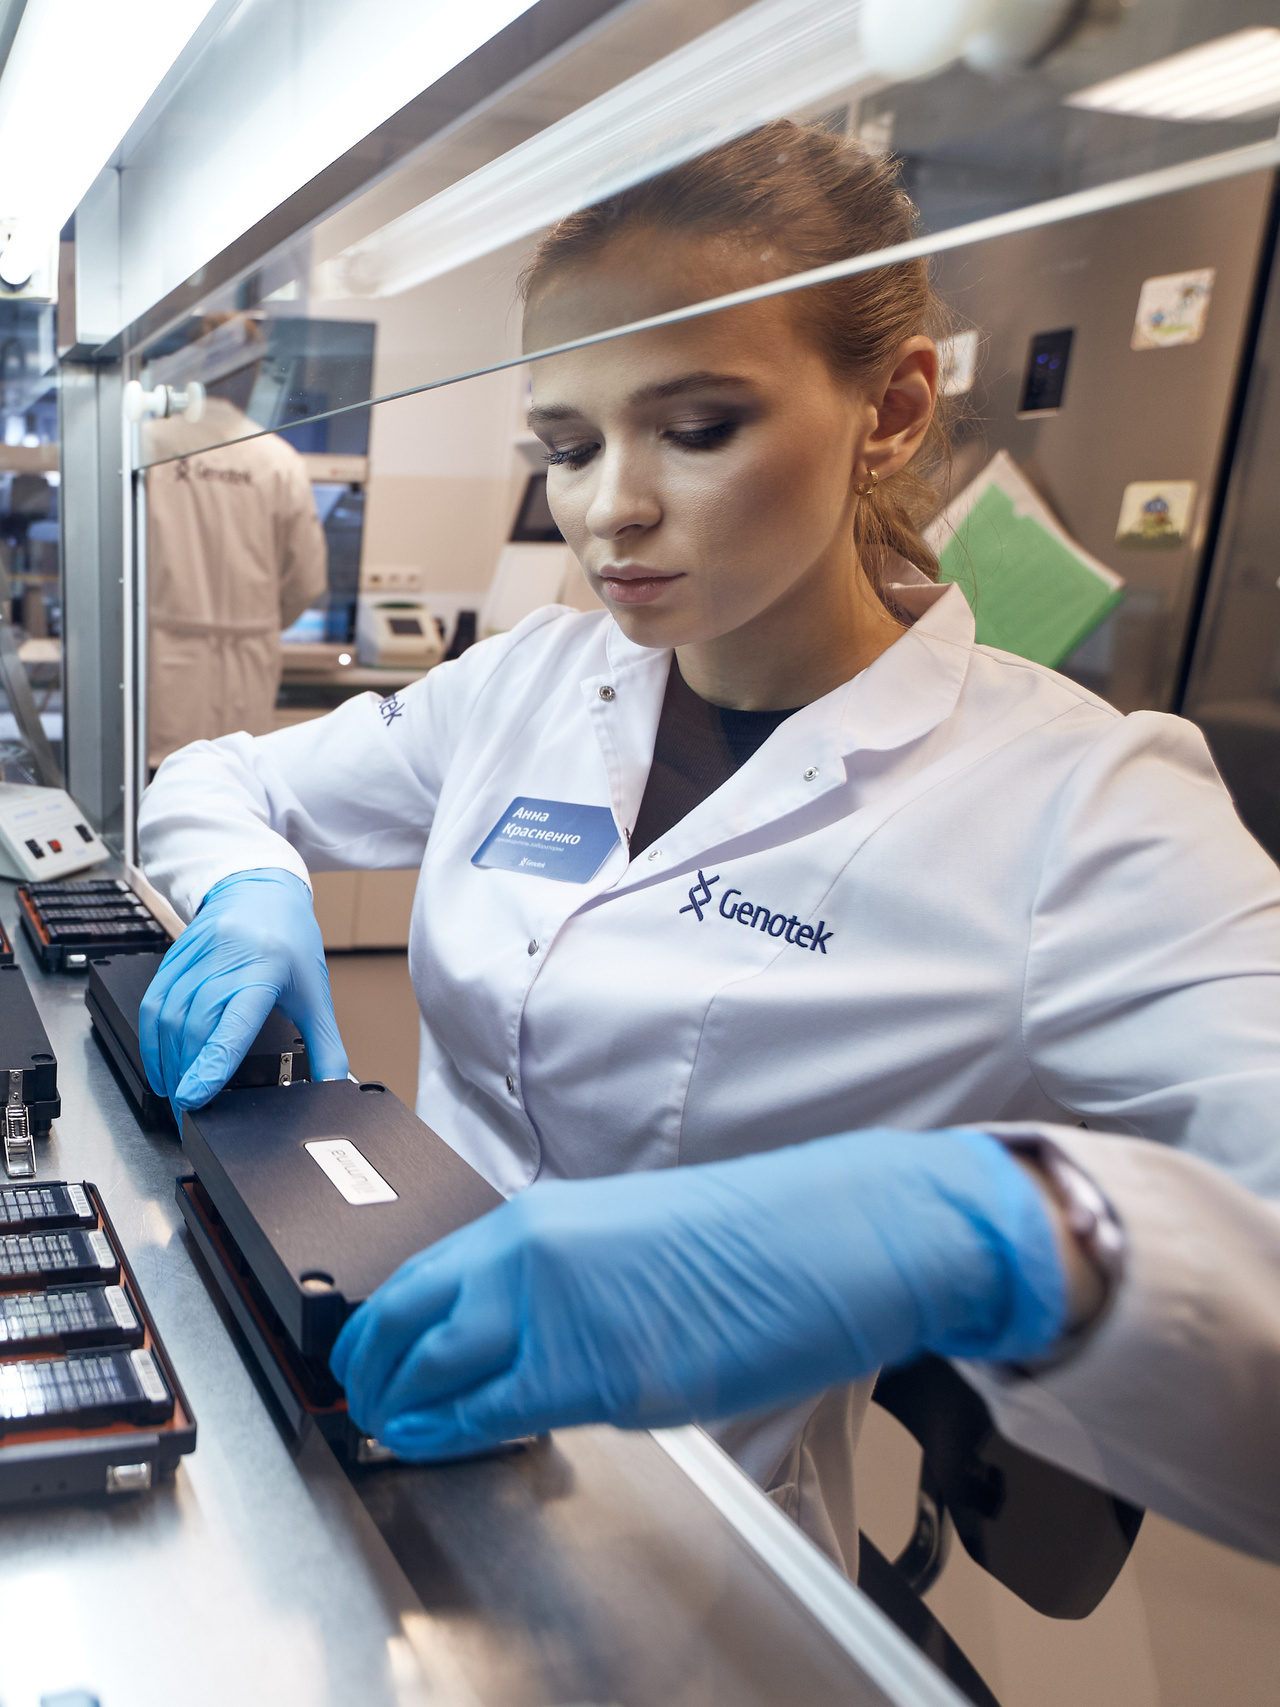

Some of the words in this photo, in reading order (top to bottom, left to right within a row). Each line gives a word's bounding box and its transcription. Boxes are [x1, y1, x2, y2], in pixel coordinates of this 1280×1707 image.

[512, 806, 550, 823] Анна
[502, 822, 581, 845] Красненко
[720, 888, 834, 955] Genotek
